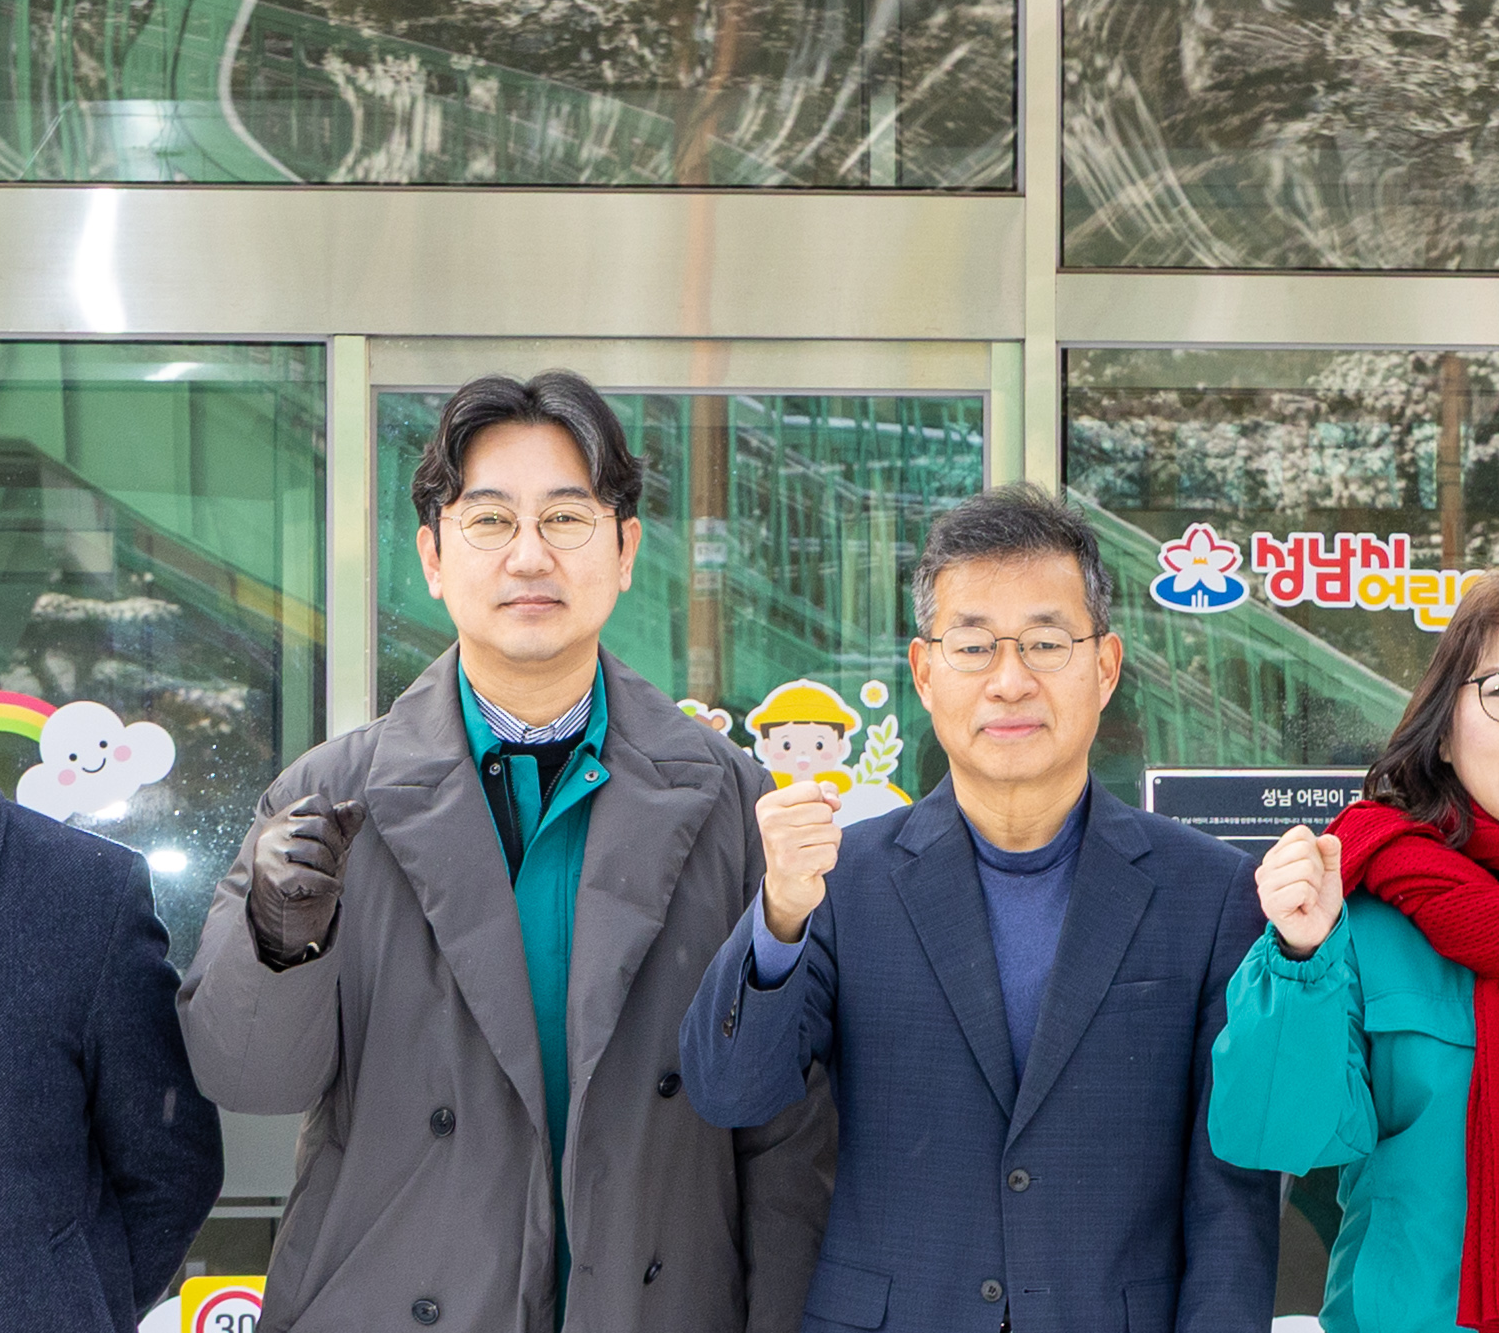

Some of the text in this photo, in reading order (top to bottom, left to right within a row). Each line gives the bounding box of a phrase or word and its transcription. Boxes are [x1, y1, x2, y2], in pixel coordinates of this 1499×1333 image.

[1256, 537, 1406, 603] 성남시
[1261, 788, 1294, 807] 성남
[1296, 788, 1345, 807] 어린이
